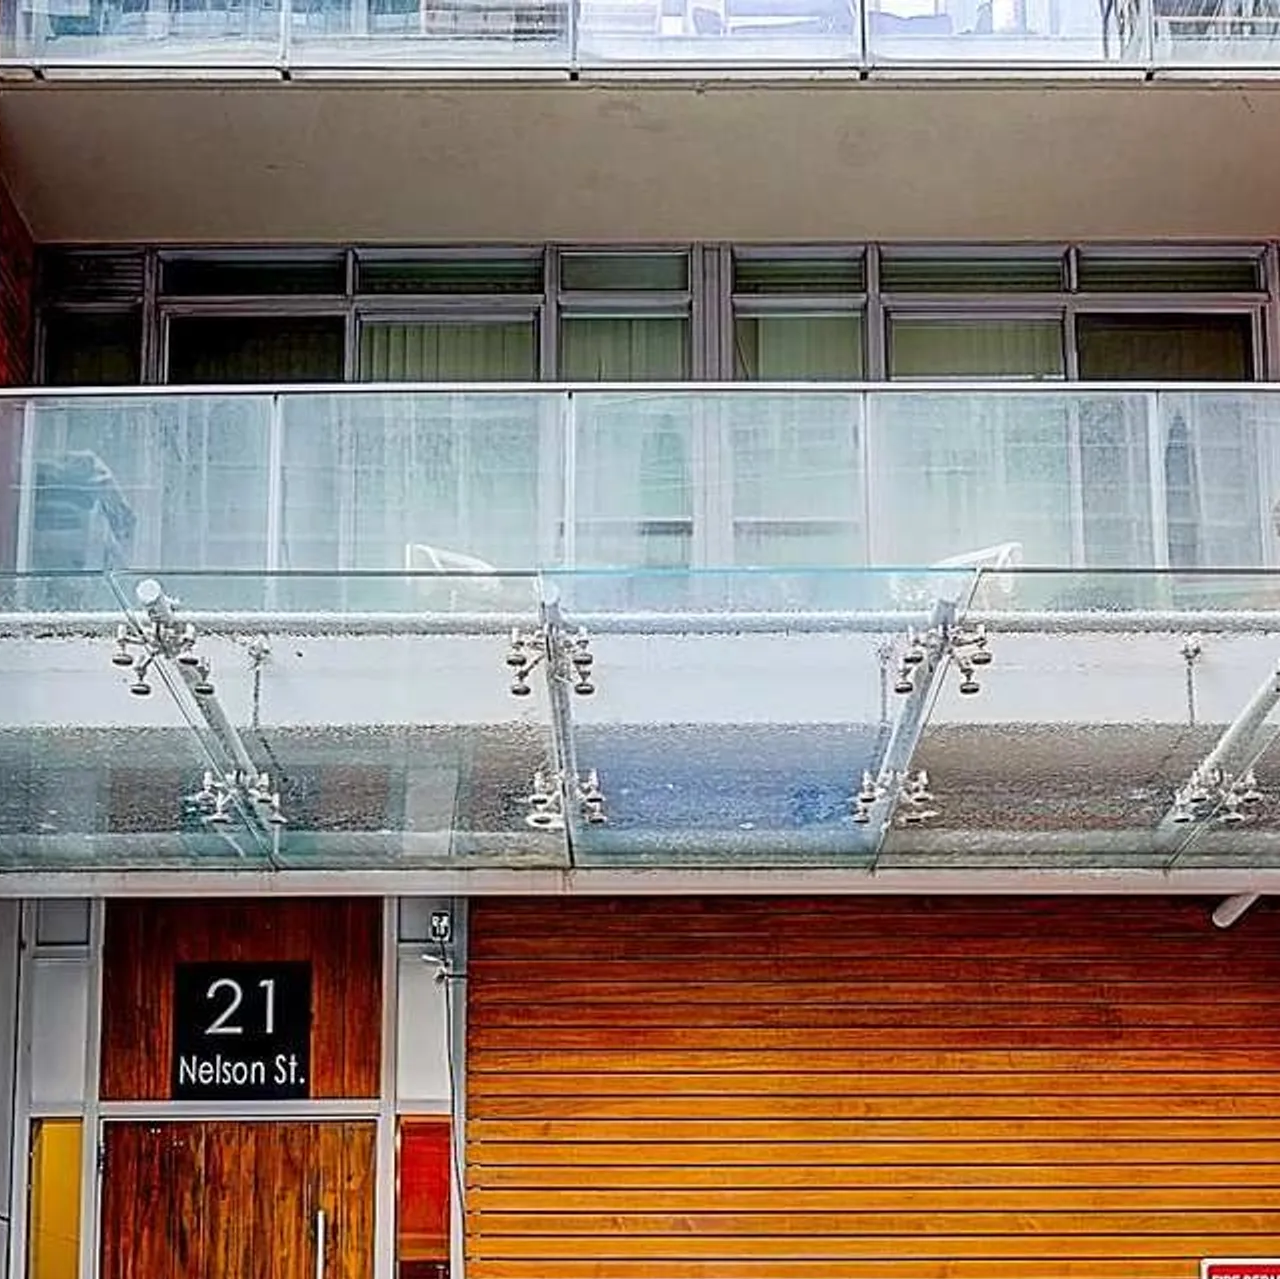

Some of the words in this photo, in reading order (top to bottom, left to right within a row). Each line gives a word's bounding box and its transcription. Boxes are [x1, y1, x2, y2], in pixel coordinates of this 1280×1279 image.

[204, 977, 275, 1035] 21
[178, 1053, 266, 1086] Nelson
[274, 1053, 306, 1085] St.
